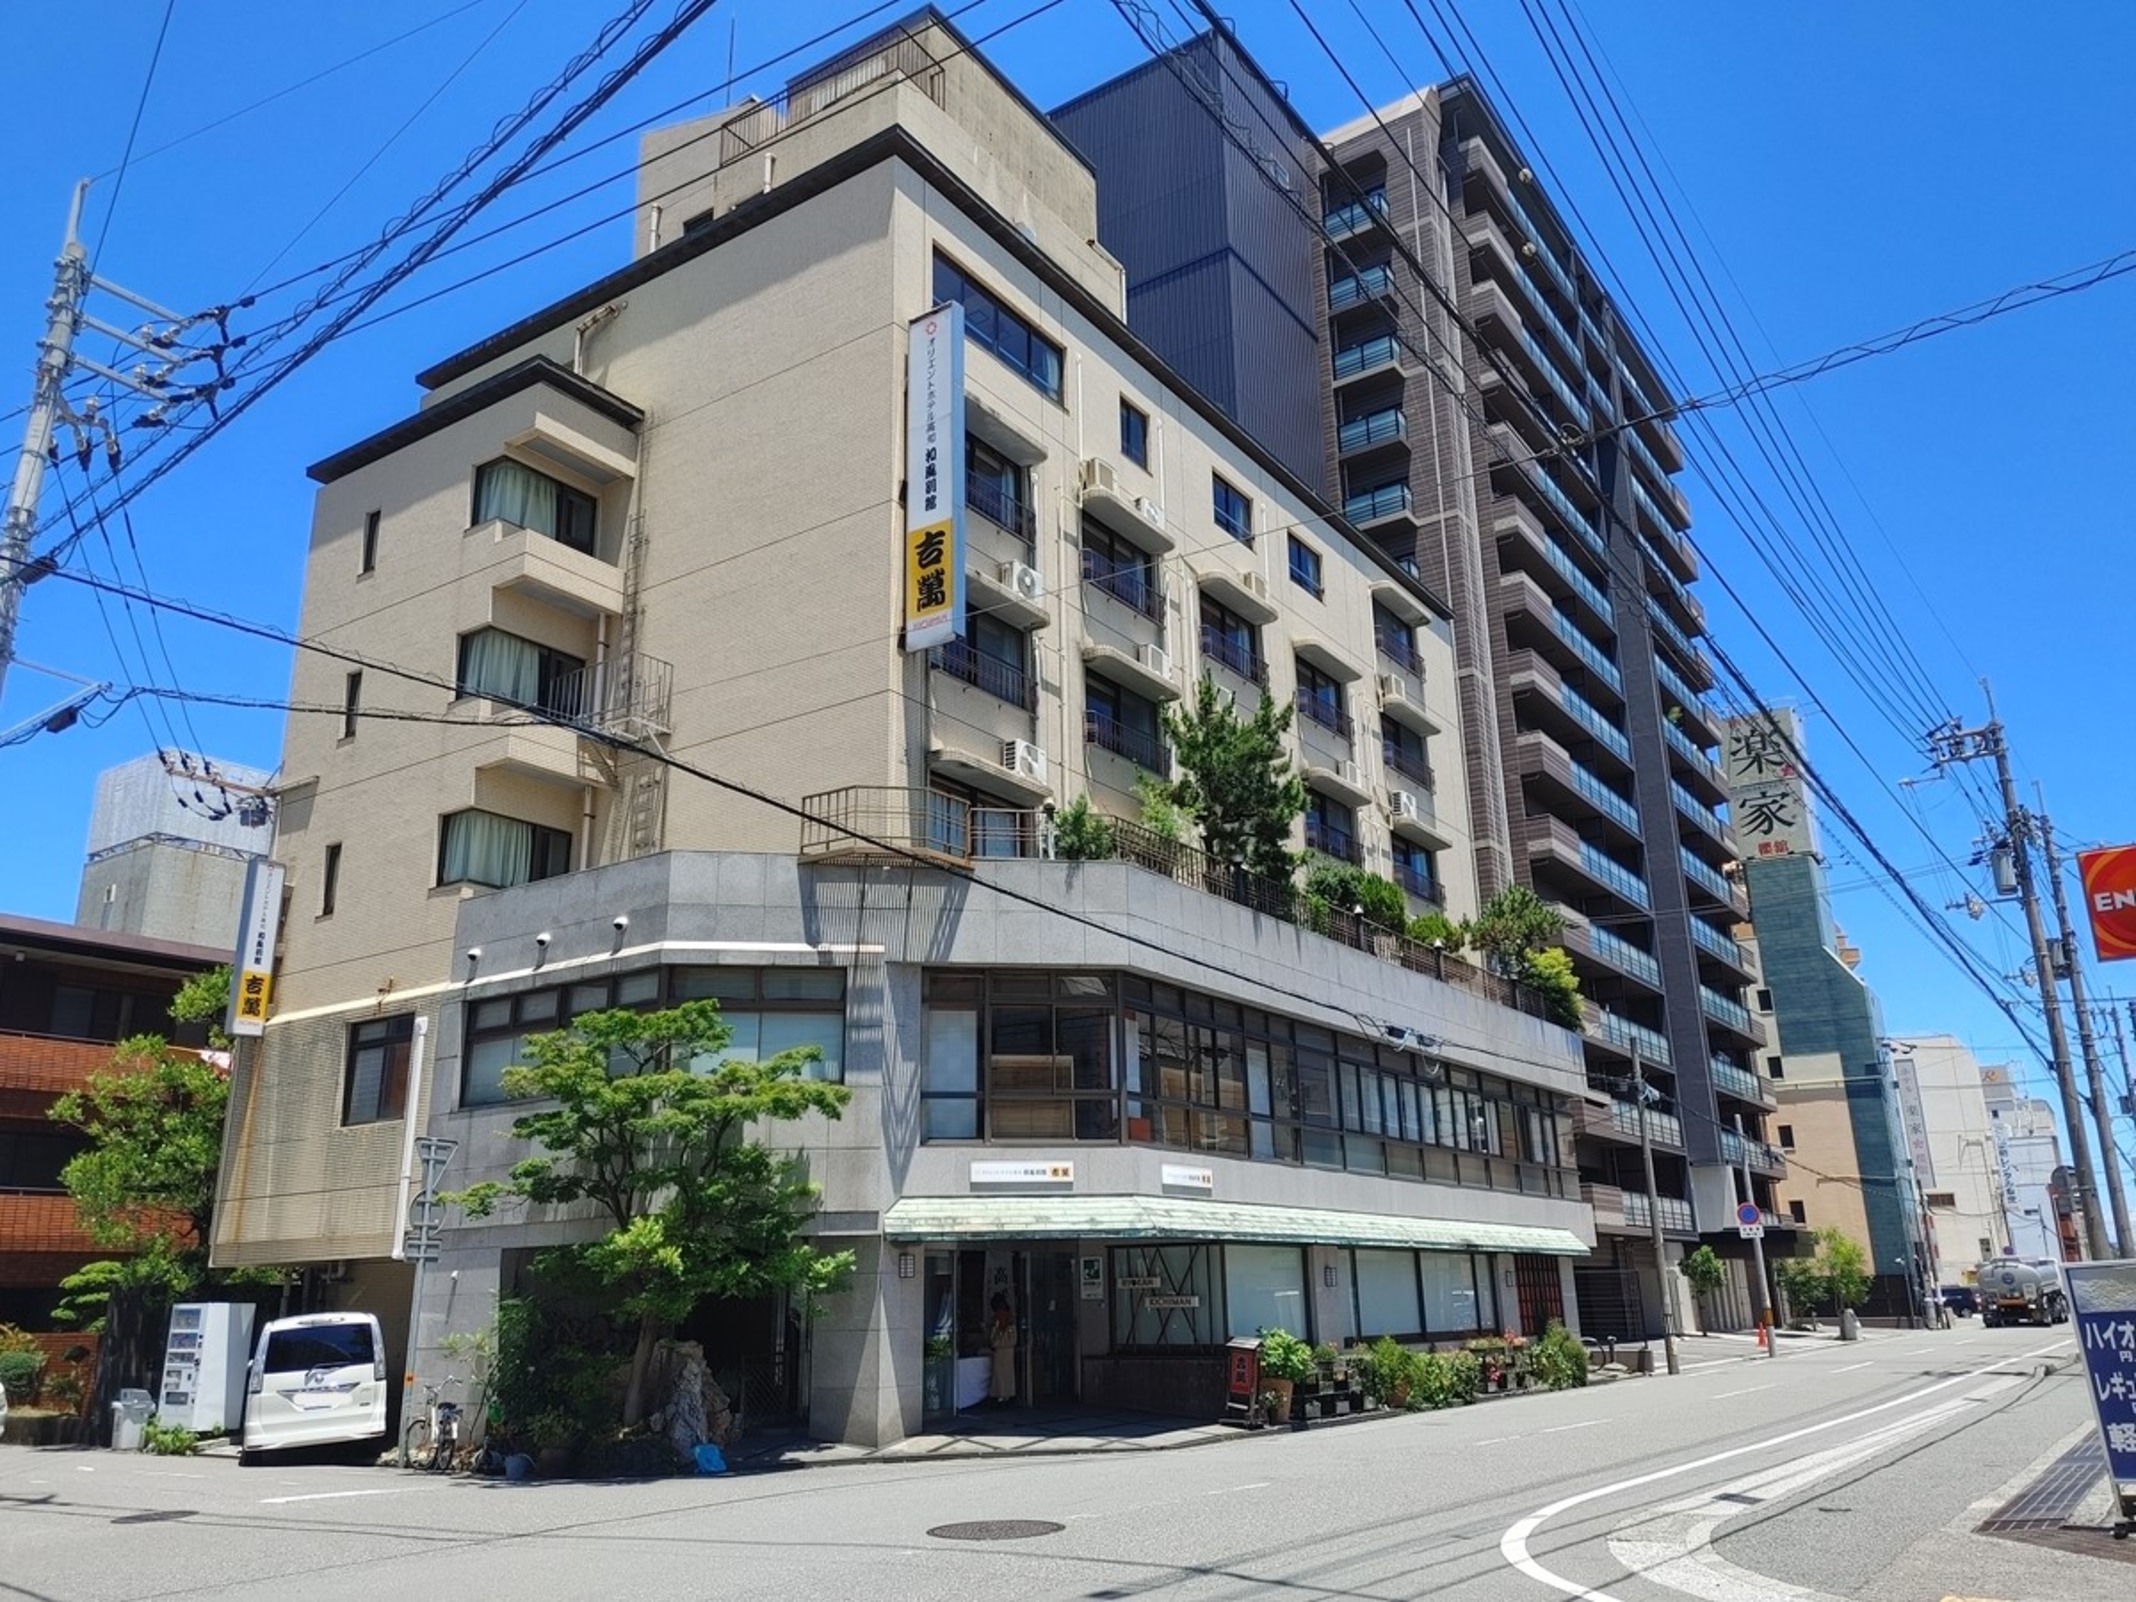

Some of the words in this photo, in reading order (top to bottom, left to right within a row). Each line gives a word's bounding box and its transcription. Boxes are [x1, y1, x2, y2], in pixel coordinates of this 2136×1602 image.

[2119, 1350, 2136, 1363] 円
[2094, 1371, 2136, 1402] レギュ
